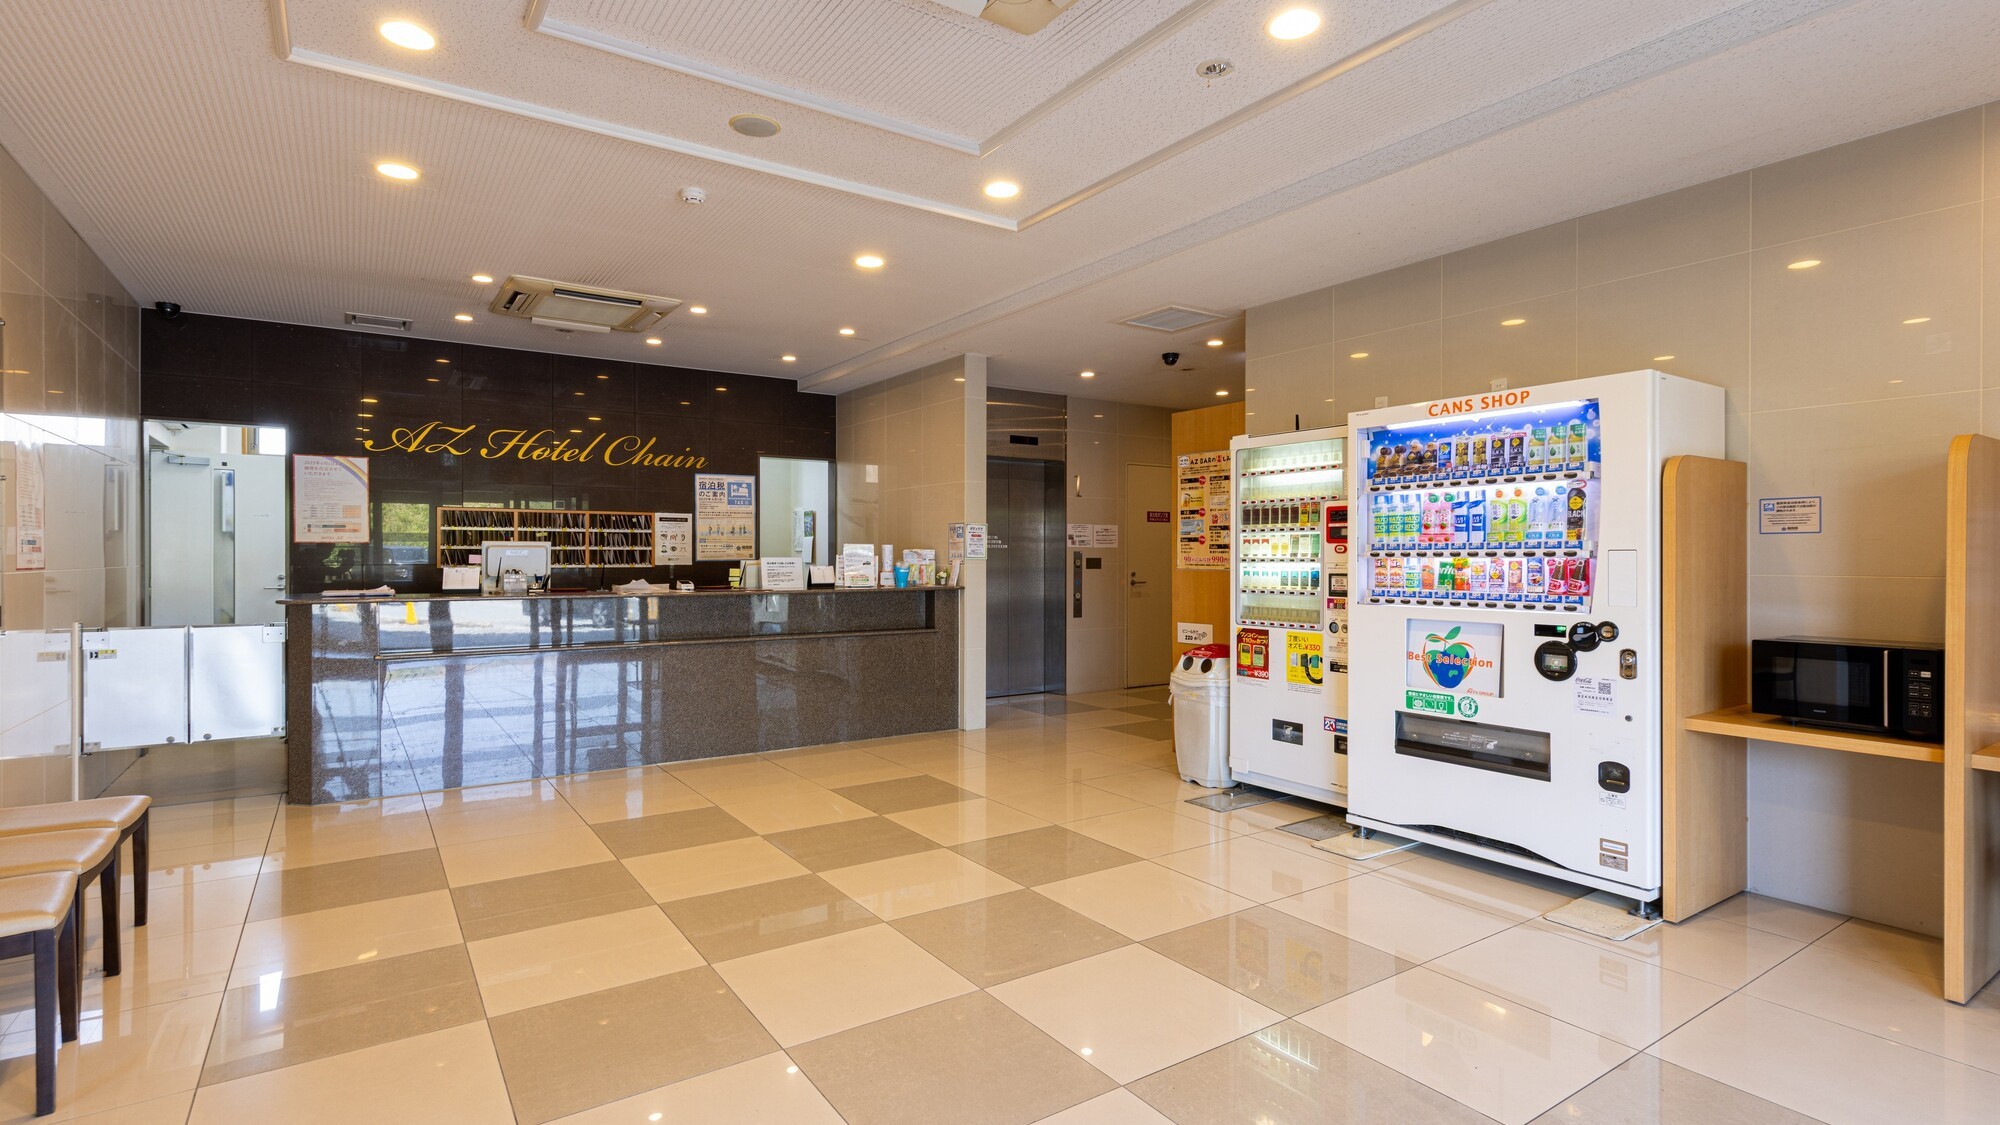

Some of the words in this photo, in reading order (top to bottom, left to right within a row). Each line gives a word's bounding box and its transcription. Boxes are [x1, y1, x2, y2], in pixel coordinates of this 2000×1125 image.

[1428, 399, 1473, 416] CANS
[1481, 390, 1530, 409] SHOP
[364, 421, 476, 456] AZ
[480, 428, 607, 463] Hotel
[603, 436, 710, 470] Chain
[1190, 458, 1199, 466] AZ
[699, 481, 725, 490] 宿泊税
[1074, 474, 1082, 497] 1
[1407, 651, 1432, 663] Best
[1436, 653, 1493, 668] Selection
